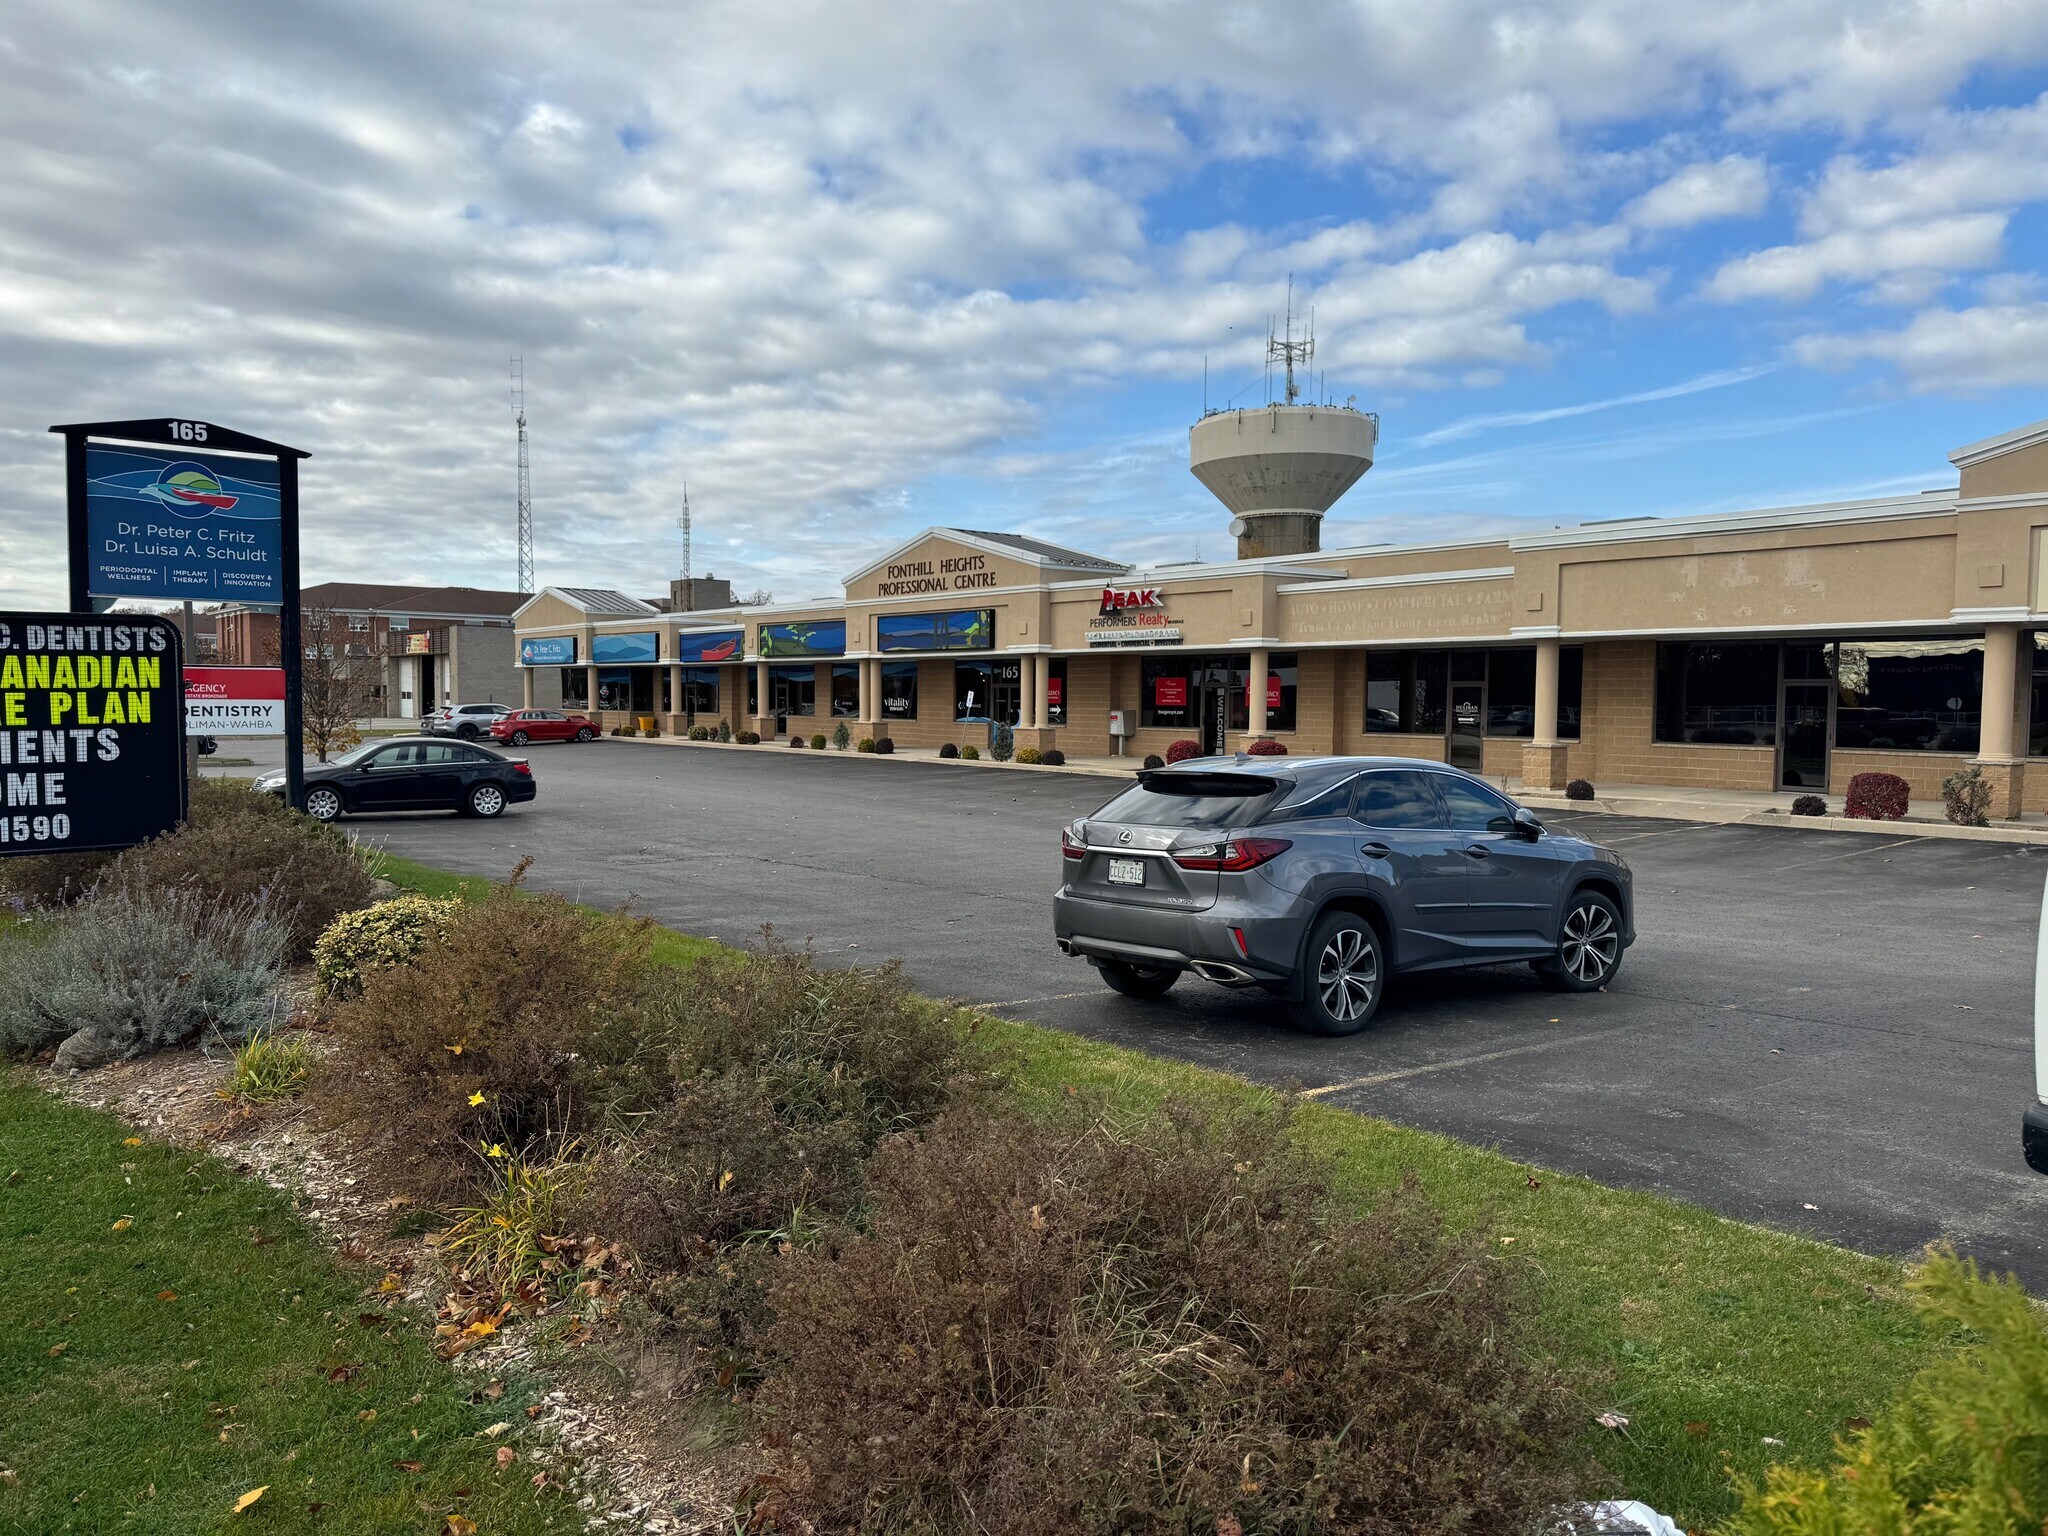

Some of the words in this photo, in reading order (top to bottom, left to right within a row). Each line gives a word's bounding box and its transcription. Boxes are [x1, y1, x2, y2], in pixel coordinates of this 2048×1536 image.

[169, 421, 208, 442] 165
[118, 522, 141, 536] Dr.
[147, 524, 192, 539] Peter
[197, 528, 213, 541] C.
[219, 529, 256, 544] Fritz
[105, 540, 128, 553] Dr.
[134, 541, 178, 556] Luisa
[184, 545, 201, 557] A.
[206, 546, 268, 562] Schuldt
[100, 565, 158, 575] PERIODONTAL
[107, 573, 151, 581] WELLNESS
[222, 572, 265, 580] DISCOVERY
[888, 561, 934, 579] FONTHILL
[940, 555, 985, 573] HEIGHTS
[172, 576, 209, 584] THERAPY
[878, 577, 948, 596] PROFESSIONAL
[954, 572, 997, 590] CENTRE
[1102, 588, 1163, 610] PEAK
[1090, 616, 1137, 628] PERFORMERS
[1139, 612, 1169, 628] Realty
[26, 625, 166, 651] DENTISTS
[0, 655, 160, 689] ANADIAN
[1002, 666, 1019, 678] 165
[0, 692, 28, 726] E
[50, 691, 151, 725] PLAN
[884, 697, 910, 710] vitality
[0, 772, 66, 807] ME
[0, 813, 71, 842] 1590
